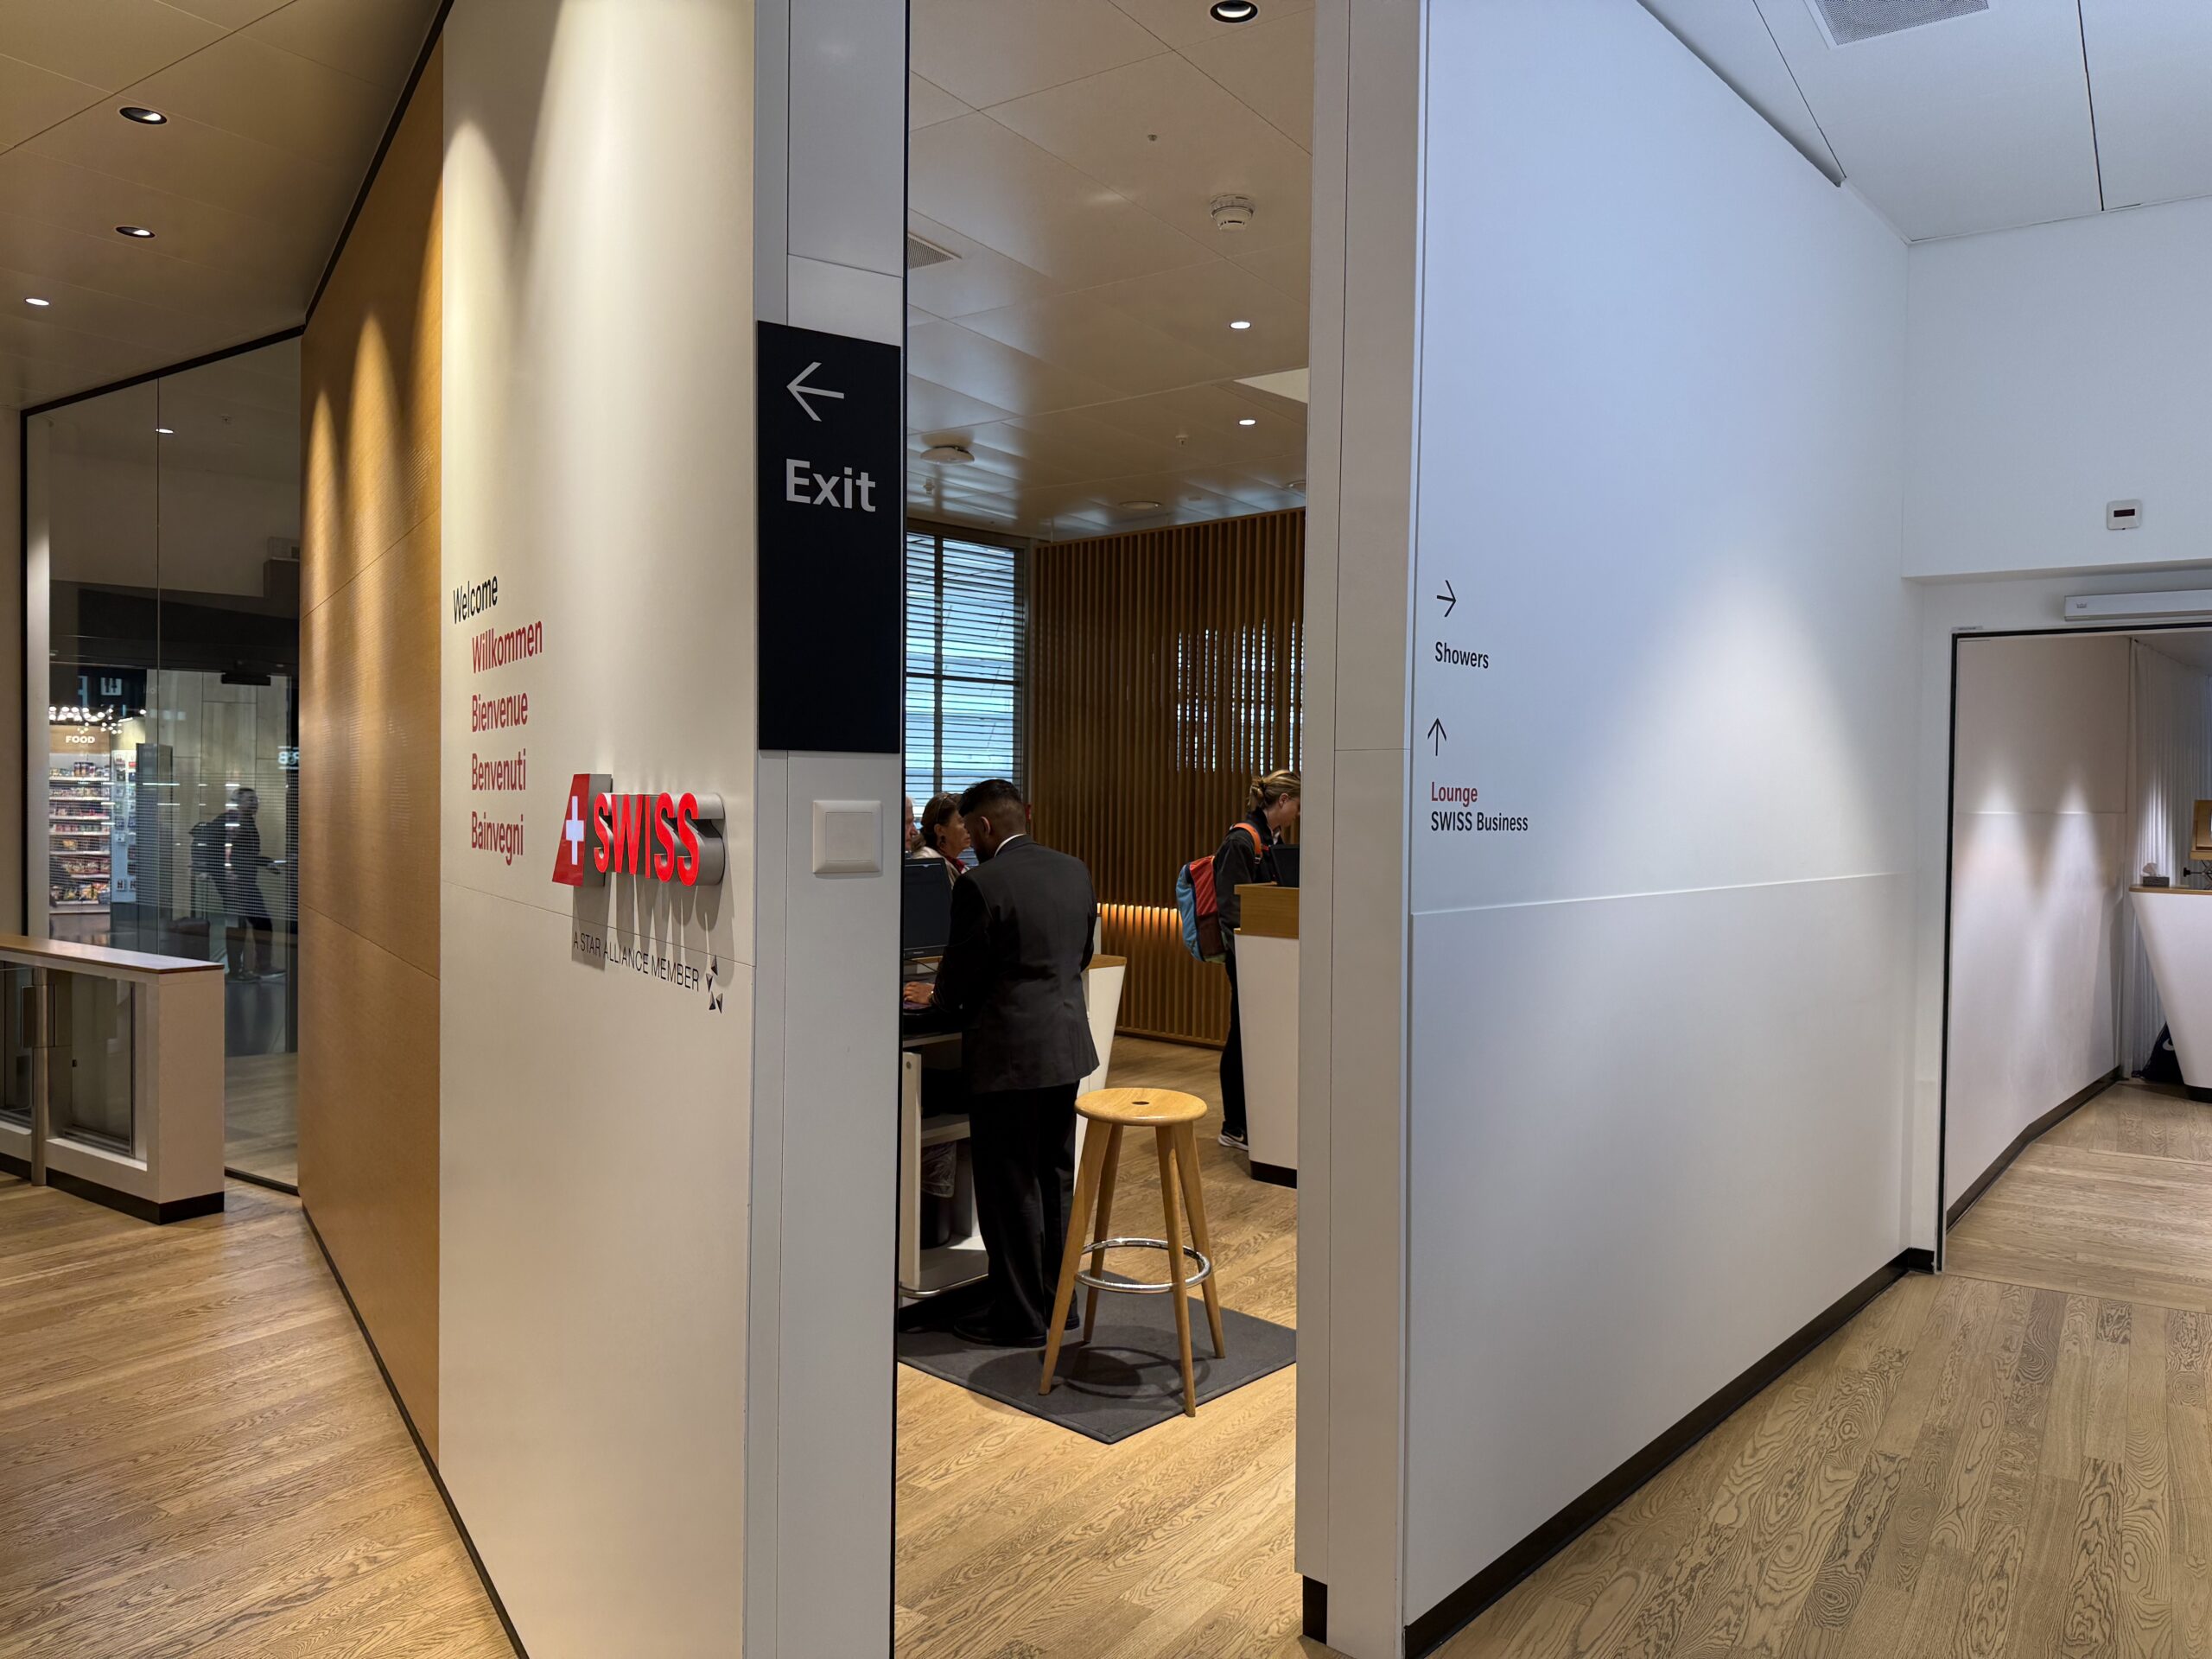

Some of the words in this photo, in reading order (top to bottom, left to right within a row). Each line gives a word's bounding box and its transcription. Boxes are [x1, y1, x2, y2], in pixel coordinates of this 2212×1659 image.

[786, 458, 876, 512] Exit
[453, 575, 499, 624] Welcome
[472, 620, 543, 674] Willkommen
[1434, 641, 1489, 669] Showers
[472, 692, 529, 733] Bienvenue
[472, 748, 526, 791] Benvenuti
[1431, 781, 1478, 808] Lounge
[472, 811, 524, 866] Bainvegni
[594, 792, 699, 887] SWISS
[1431, 810, 1473, 832] SWISS
[1476, 811, 1529, 832] Business
[574, 931, 579, 949] A
[580, 933, 601, 958] STAR
[603, 942, 649, 975] ALLIANCE
[652, 956, 700, 992] MEMBER
